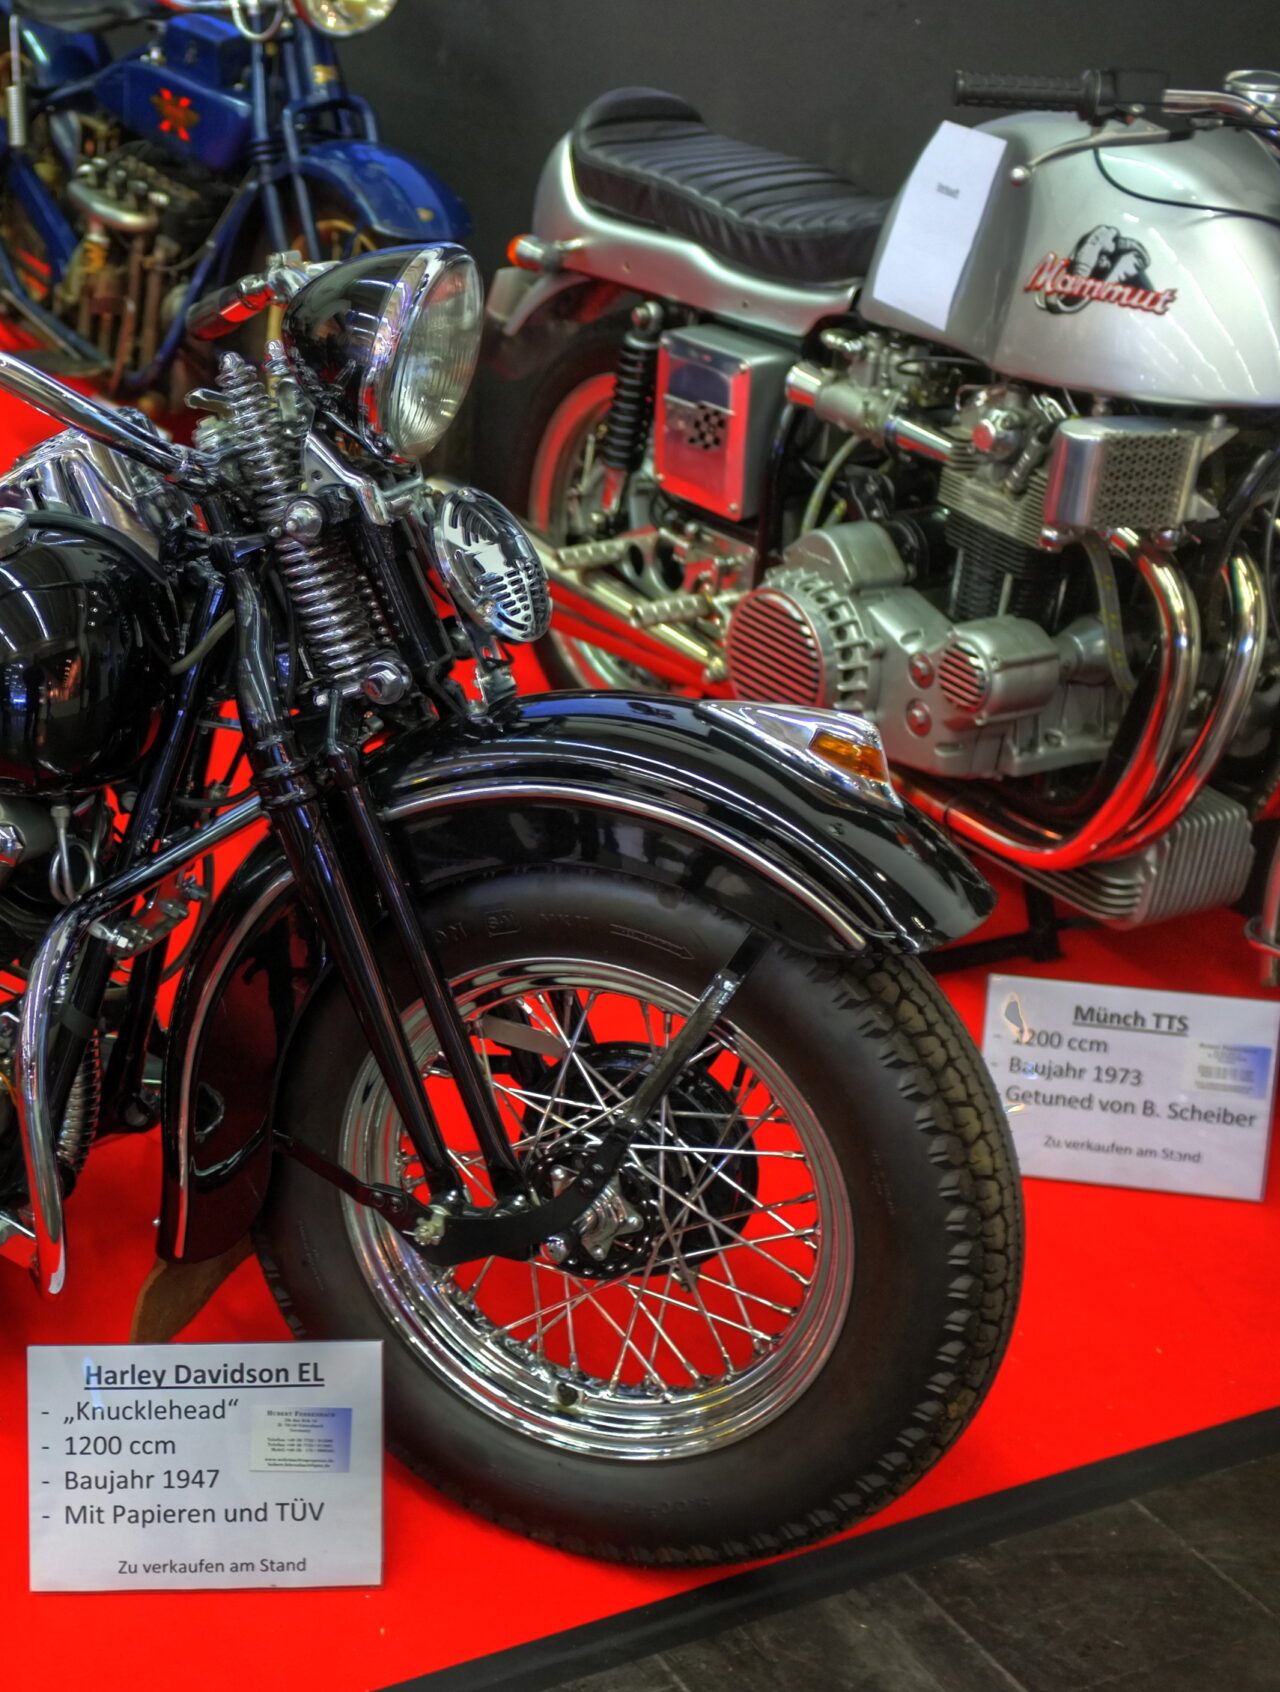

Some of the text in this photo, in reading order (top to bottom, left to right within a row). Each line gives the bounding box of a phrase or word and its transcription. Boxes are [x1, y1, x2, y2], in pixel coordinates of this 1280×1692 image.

[1024, 252, 1178, 315] Mammut
[1073, 1005, 1190, 1032] Münch TTS
[1067, 1036, 1109, 1053] ccm
[1009, 1057, 1142, 1086] Baujahr 1973
[1006, 1086, 1257, 1128] Getuned von B. Scheiber
[1044, 1135, 1202, 1163] Zu verkaufen am Stand
[85, 1362, 324, 1388] Harley Davidson EL
[65, 1435, 176, 1455] 1200 ccm
[65, 1469, 220, 1494] Baujahr 1947
[65, 1498, 325, 1528] Mit Papieren und TÜV
[118, 1557, 306, 1574] Zu verkaufen am Stand
